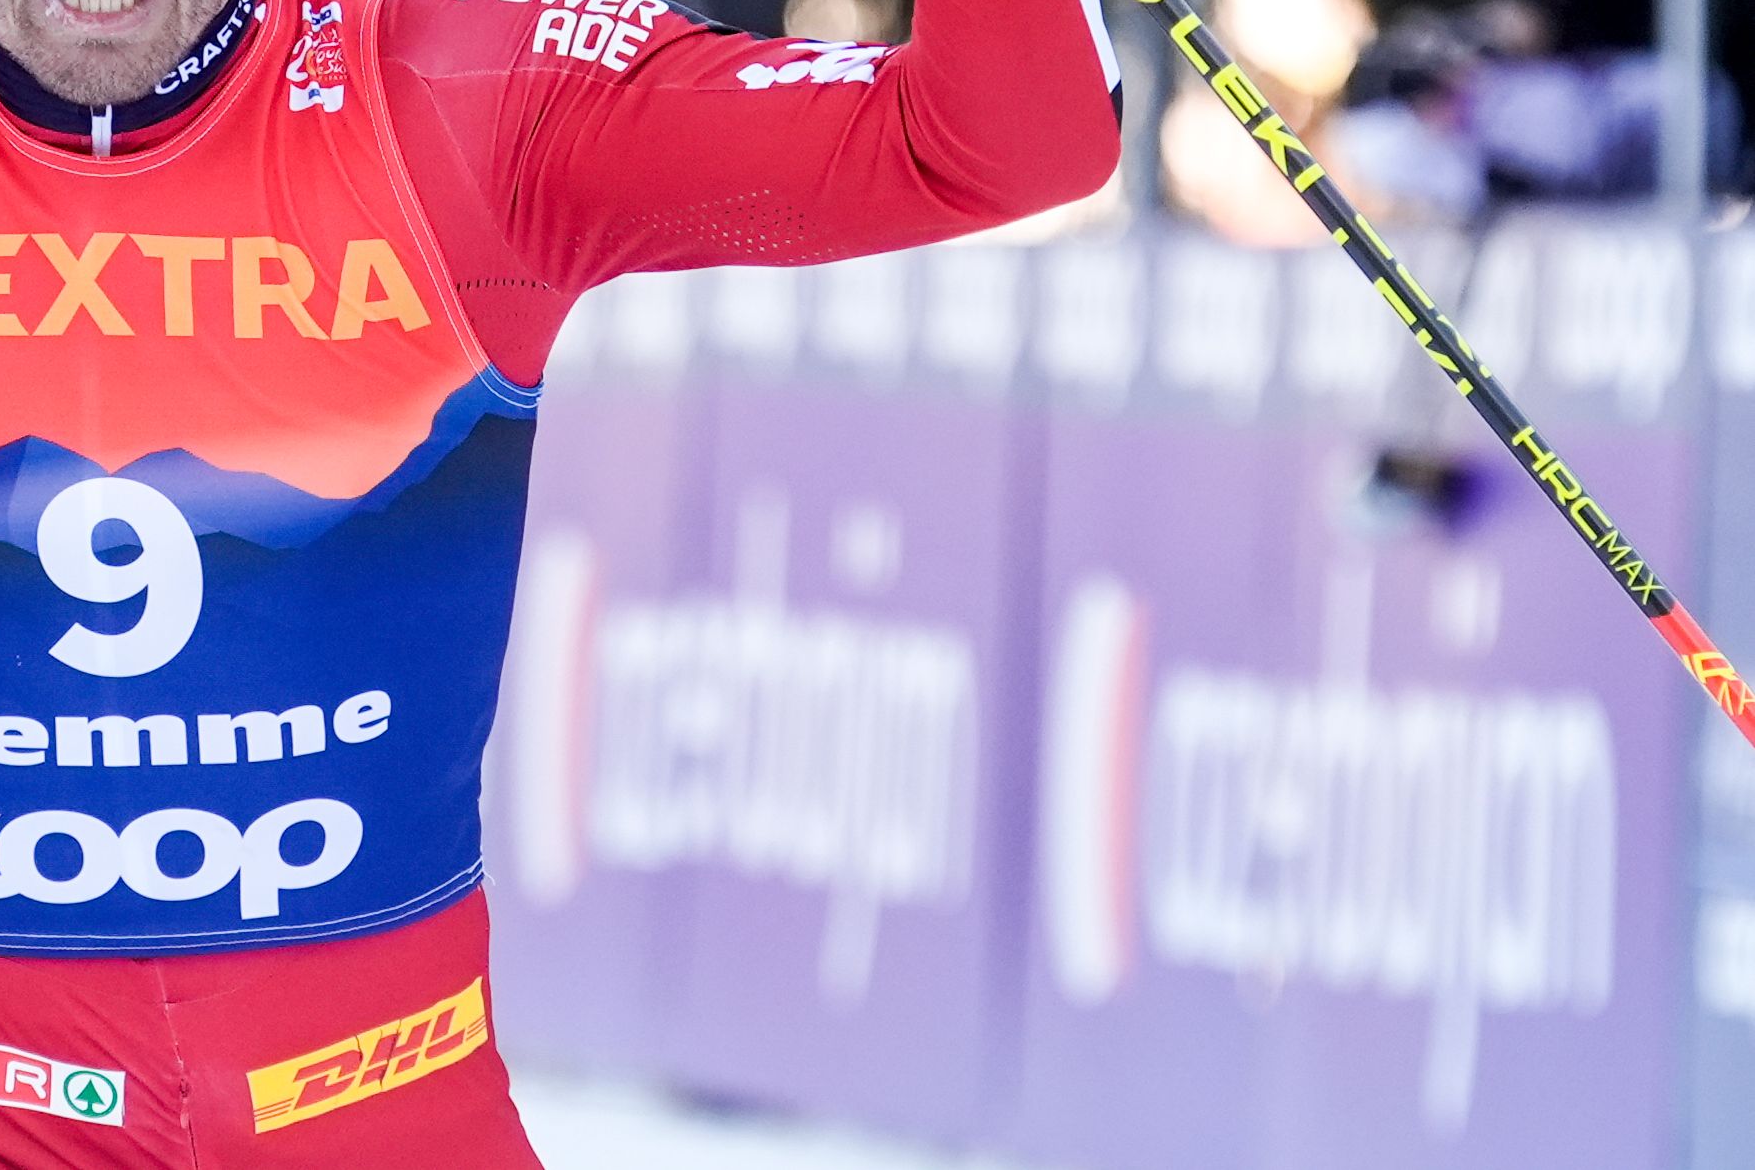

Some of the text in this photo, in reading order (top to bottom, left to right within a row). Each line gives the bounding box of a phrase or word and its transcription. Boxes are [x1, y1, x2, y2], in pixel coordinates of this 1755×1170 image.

[155, 7, 243, 94] CRAFT
[532, 8, 649, 72] ADE
[1171, 13, 1325, 193] LEKI
[37, 476, 204, 678] 9
[1512, 426, 1665, 606] HRC MAX
[293, 1006, 468, 1109] DHL
